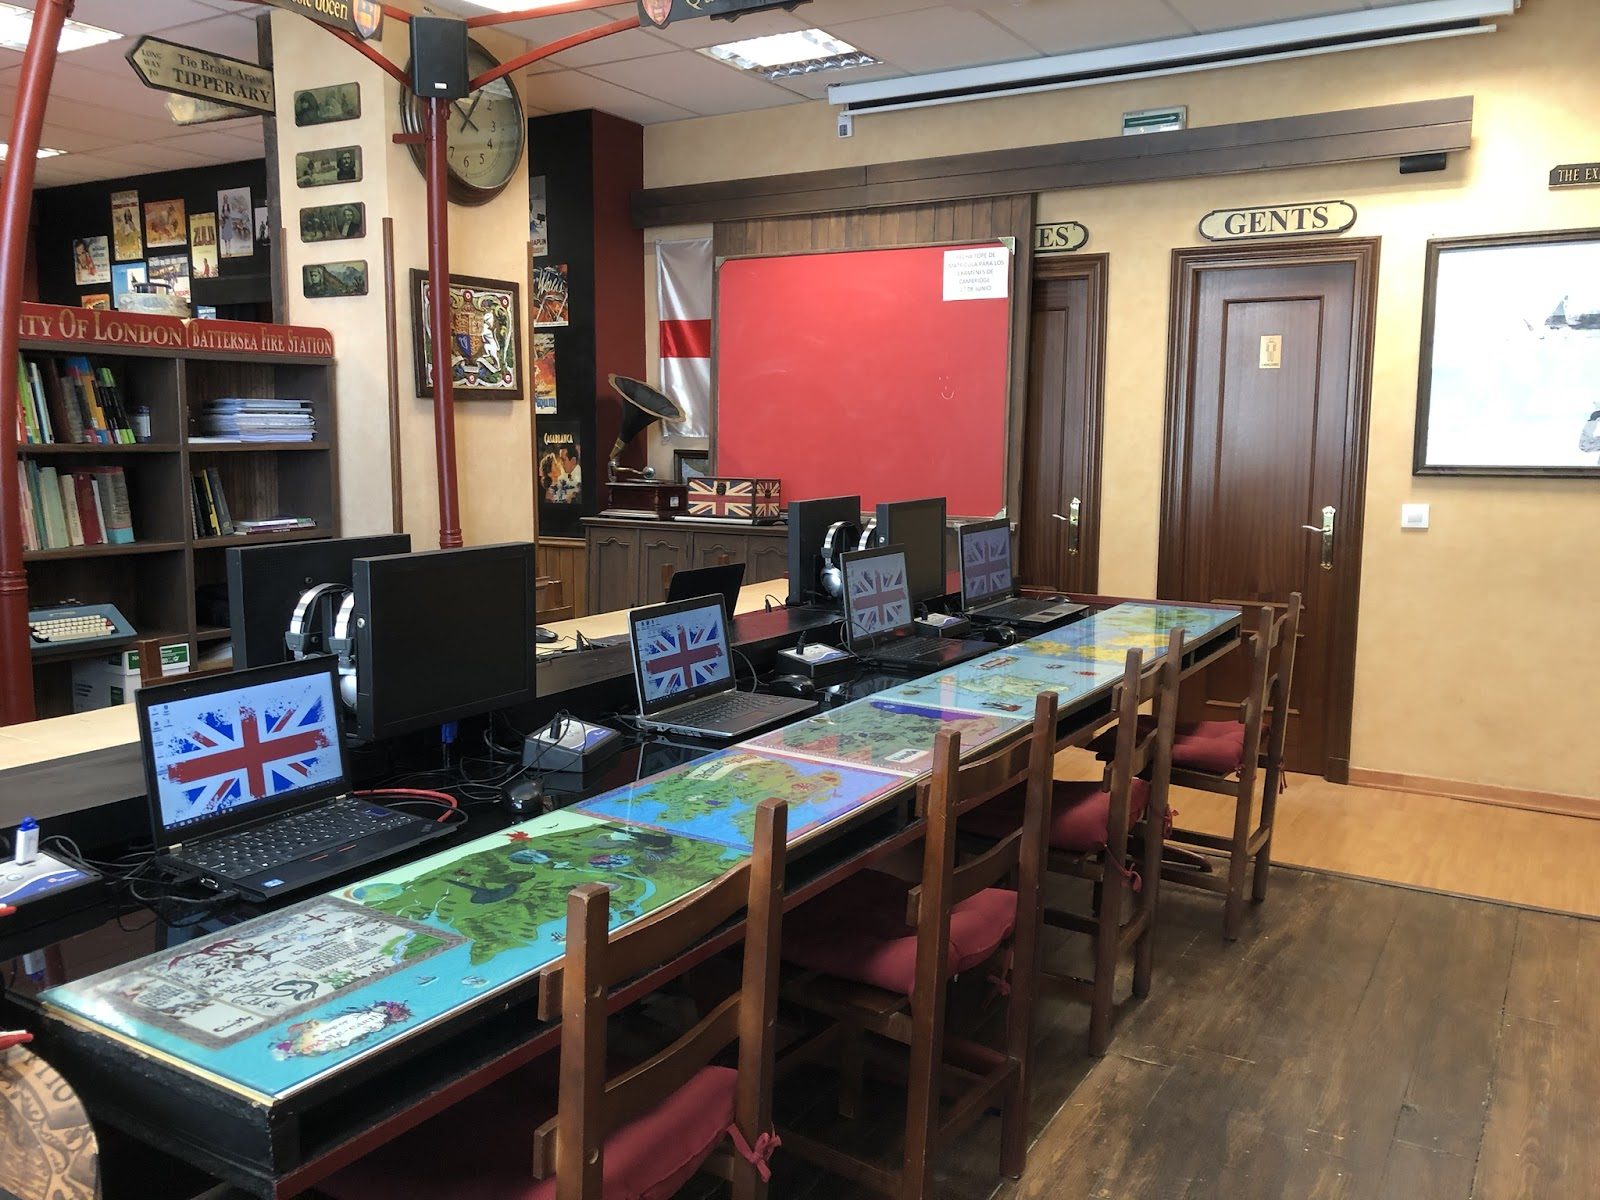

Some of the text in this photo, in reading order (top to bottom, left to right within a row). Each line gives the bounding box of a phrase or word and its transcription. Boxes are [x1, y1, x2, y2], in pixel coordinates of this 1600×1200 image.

[148, 68, 158, 77] TO
[201, 60, 232, 77] Braid
[172, 68, 270, 104] TIPPERARY
[491, 121, 496, 132] 3
[487, 138, 493, 150] 4
[449, 146, 455, 159] 7
[480, 153, 485, 164] 5
[464, 156, 470, 168] 6
[1558, 168, 1600, 182] THE EX
[1224, 206, 1329, 235] GENTS
[1038, 226, 1069, 248] ES
[19, 315, 52, 336] ITY
[94, 312, 182, 346] LONDON
[192, 322, 332, 355] BATTERSEA FIRE STATION
